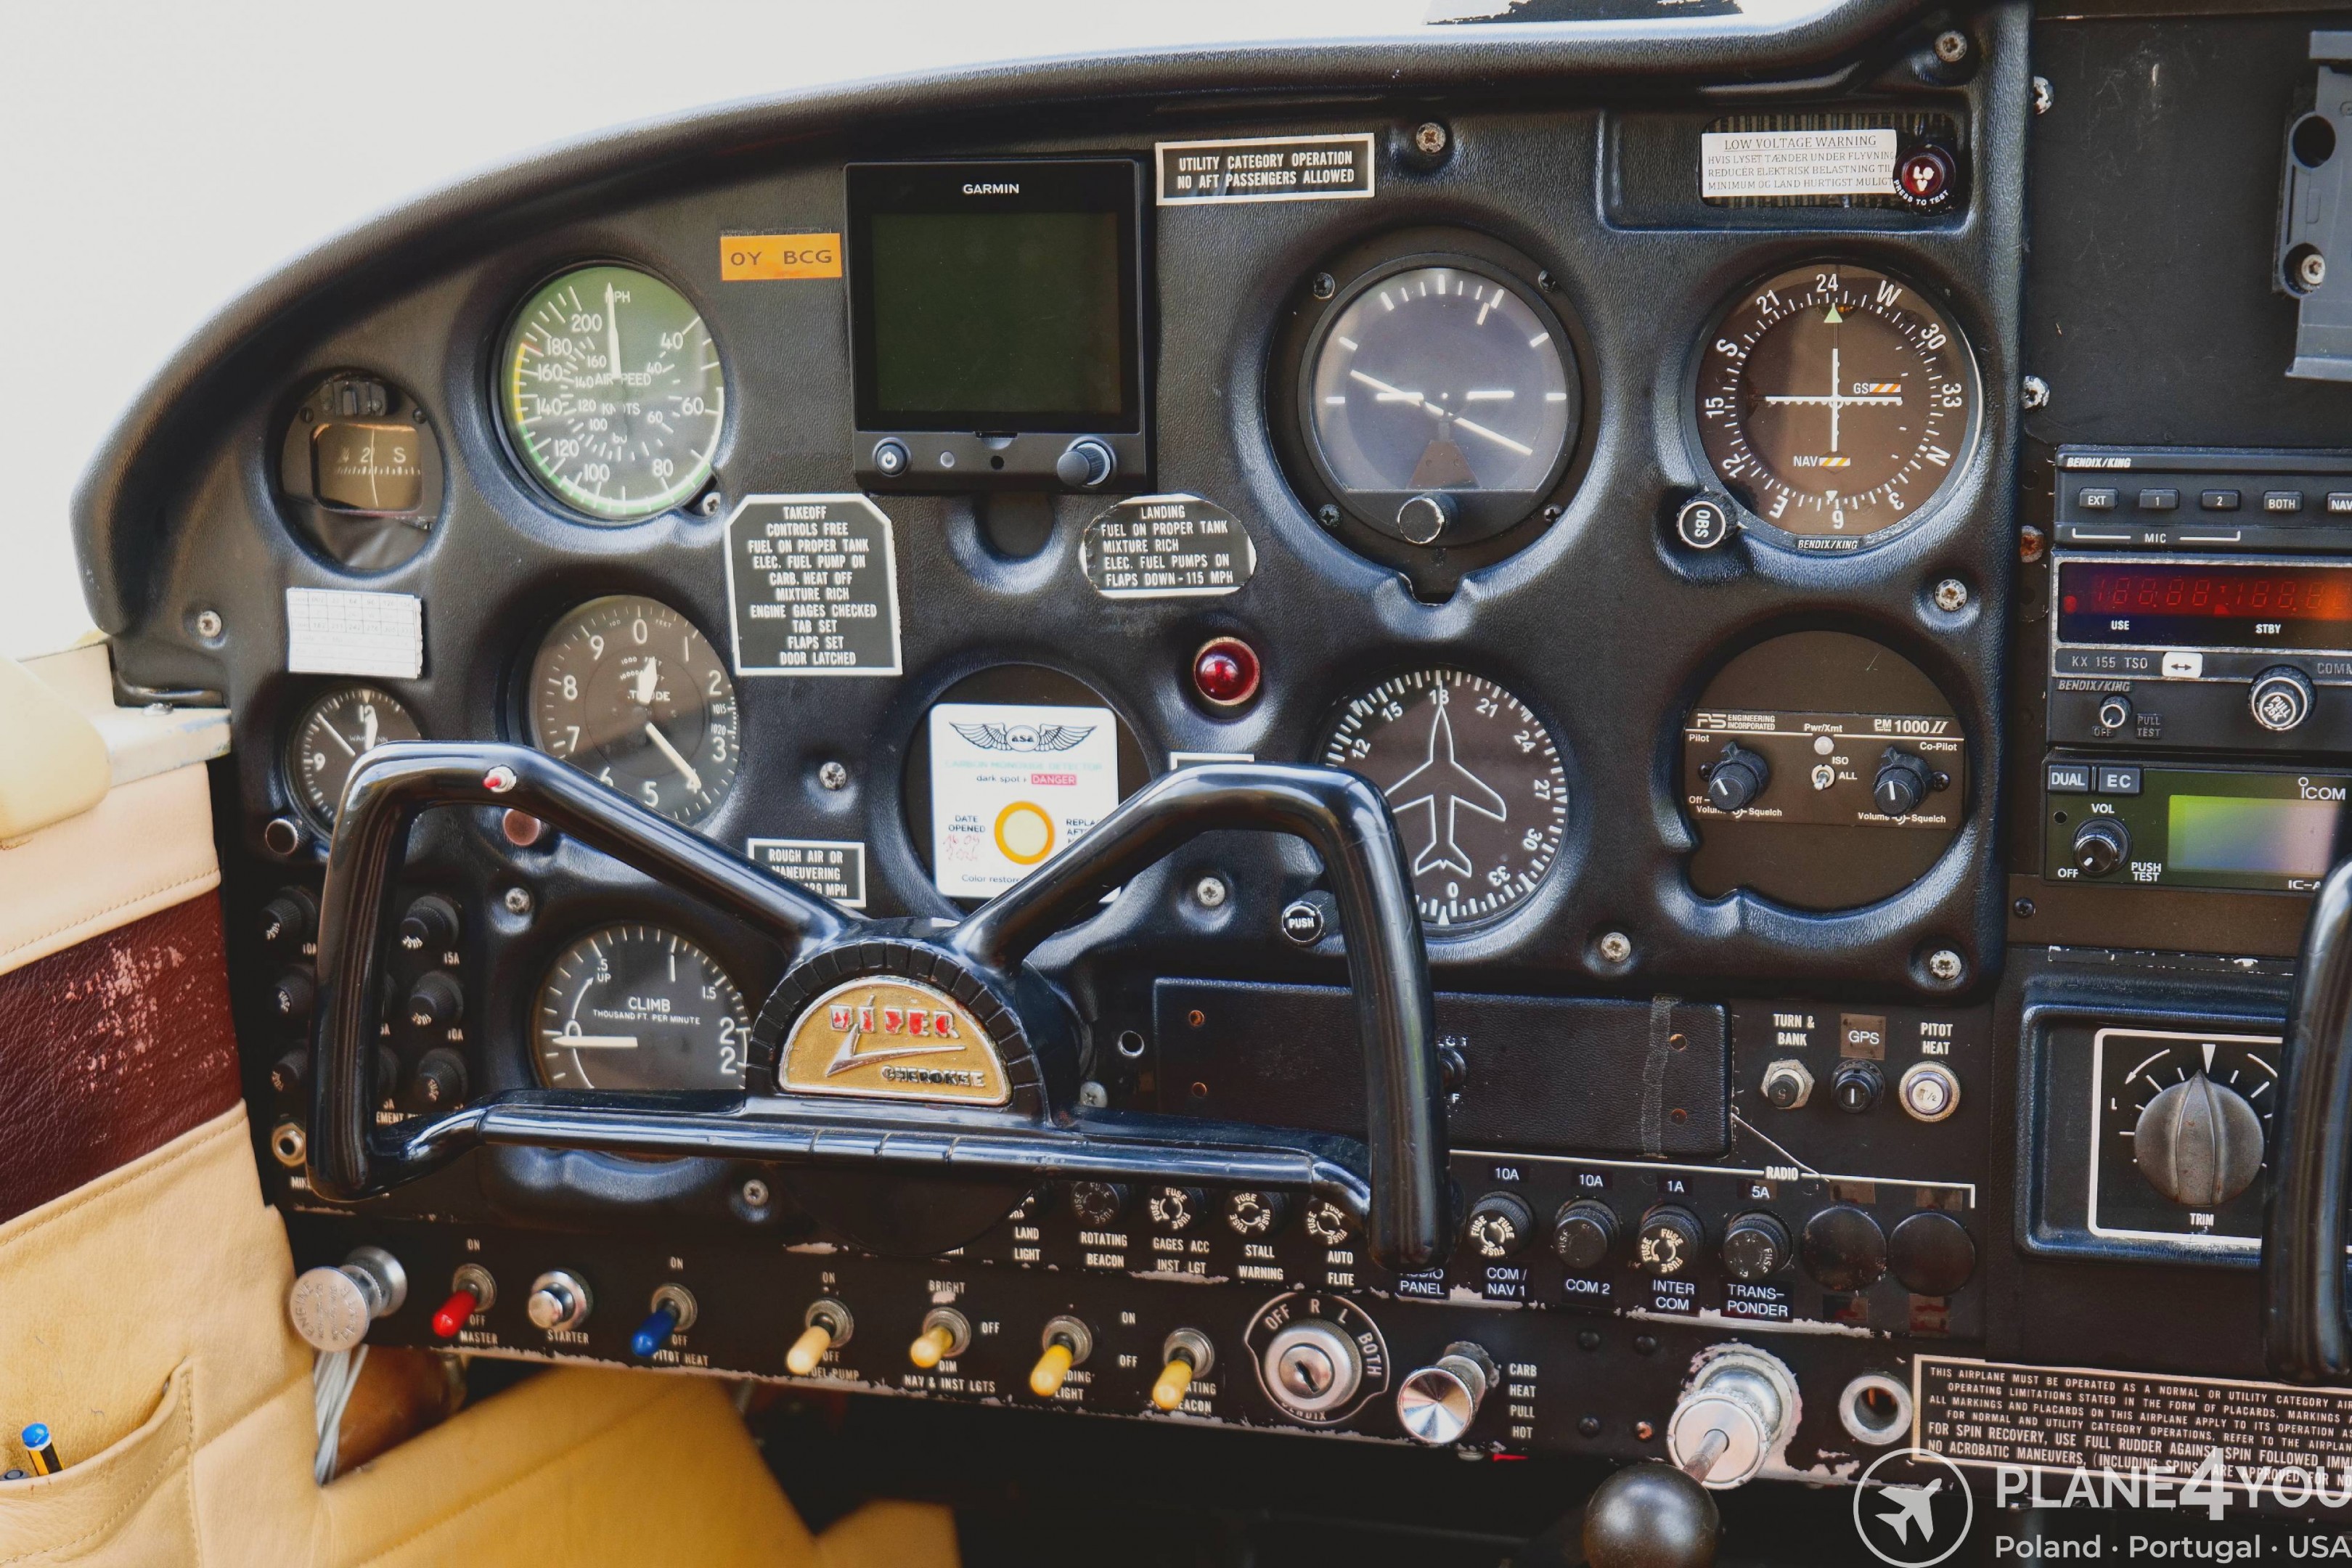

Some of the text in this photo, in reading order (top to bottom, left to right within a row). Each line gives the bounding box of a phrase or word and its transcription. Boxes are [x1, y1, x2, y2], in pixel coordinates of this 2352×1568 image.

[1725, 136, 1876, 150] LOW VOLTAGE WARNING
[1180, 151, 1352, 171] UTILITY CATEGORY OPERATION
[1708, 152, 1845, 164] HVIS LYSET TÆNDER UNDER
[1177, 169, 1354, 189] NO AFT PASSENGERS ALLOWED
[1709, 178, 1853, 189] MINIMUM OG LAND HURTIGST
[963, 184, 1019, 194] GARMIN
[731, 250, 832, 266] OY BCG
[1816, 274, 1837, 292] 24
[1878, 280, 1902, 306] W
[572, 314, 601, 332] 200
[547, 339, 572, 356] 180
[537, 364, 563, 381] 160
[1853, 383, 1869, 393] GS
[682, 399, 703, 415] 60
[1794, 456, 1818, 466] NAV
[2067, 457, 2131, 468] BENDIX/KING
[584, 463, 610, 481] 100
[653, 460, 674, 477] 80
[2088, 495, 2106, 506] EXT
[2269, 497, 2295, 510] BOTH
[783, 507, 827, 520] TAKEOFF
[1141, 505, 1185, 520] LANDING
[767, 523, 849, 536] CONTROLS FREE
[1101, 520, 1228, 537] FUEL ON PROPER TANK
[1694, 509, 1710, 538] OBS
[1798, 539, 1858, 549] BENDIX/KING
[2144, 532, 2166, 543] MIC
[748, 539, 869, 553] FUEL ON PROPER TANK
[1103, 539, 1179, 552] MIXTURE RICH
[754, 555, 865, 569] ELEC. FUEL PUMP ON
[776, 588, 849, 600] MIXTURE RICH
[751, 605, 877, 618] ENGINE GAGES CHECKED
[2111, 621, 2129, 631] USE
[2256, 624, 2281, 634] STBY
[780, 652, 856, 665] DOOR LATCHED
[2072, 656, 2148, 669] KX 155 TSO
[564, 676, 577, 700] 8
[1475, 698, 1498, 718] 21
[1728, 714, 1775, 723] ENGINEERING
[1805, 724, 1842, 733] Pwr/Xmt
[1895, 720, 1930, 733] 1000
[1920, 741, 1957, 751] Co-Pilot
[1832, 756, 1849, 765] ISO
[1032, 775, 1075, 784] DANGER
[2051, 772, 2085, 786] DUAL
[2107, 775, 2131, 788] EC
[1749, 808, 1782, 817] Squelch
[2091, 804, 2115, 814] VOL
[769, 849, 843, 863] ROUGH AIR OR
[2058, 868, 2078, 878] OFF
[2131, 862, 2161, 873] PUSH
[2133, 871, 2160, 882] TEST
[827, 884, 847, 897] MPH
[1289, 918, 1315, 928] PUSH
[703, 987, 716, 1000] 1.5
[628, 997, 670, 1012] CLIMB
[593, 1009, 635, 1020] THOUSAND
[670, 1016, 701, 1025] MINUTE
[1773, 1014, 1815, 1028] TURN &
[1922, 1022, 1953, 1037] PITOT
[1778, 1032, 1807, 1046] BANK
[1849, 1030, 1879, 1044] GPS
[1923, 1042, 1950, 1054] HEAT
[1495, 1168, 1519, 1181] 10A
[1765, 1167, 1798, 1180] RADIO
[1578, 1174, 1603, 1188] 10A
[2190, 1213, 2214, 1226] TRIM
[1081, 1231, 1127, 1247] ROTATING
[1153, 1238, 1209, 1252] GAGES ACC
[1015, 1249, 1040, 1261] LIGHT
[1246, 1244, 1275, 1258] STALL
[1328, 1251, 1352, 1264] AUTO
[1087, 1254, 1124, 1267] BEACON
[1238, 1265, 1283, 1281] WARNING
[1328, 1273, 1355, 1286] FLITE
[928, 1280, 965, 1294] BRIGHT
[1400, 1281, 1445, 1294] PANEL
[1566, 1279, 1610, 1294] COM 2
[1654, 1280, 1694, 1294] INTER
[1728, 1283, 1784, 1299] TRANS-
[1310, 1299, 1320, 1313] R
[1656, 1297, 1689, 1310] COM
[1728, 1301, 1788, 1316] PONDER
[1122, 1312, 1136, 1324] ON
[1265, 1304, 1289, 1330] OFF
[982, 1322, 1000, 1334] OFF
[460, 1331, 497, 1344] MASTER
[547, 1329, 589, 1344] STARTER
[685, 1353, 709, 1366] HEAT
[1358, 1332, 1382, 1377] BOTH
[1119, 1355, 1138, 1368] OFF
[1510, 1363, 1537, 1377] CARB
[1931, 1367, 2115, 1392] THIS AIRPLANE MUST BE OPERATED
[1510, 1384, 1536, 1397] HEAT
[1511, 1405, 1535, 1418] PULL
[1513, 1426, 1532, 1438] HOT
[1928, 1422, 2162, 1452] FOR SPIN RECOVERY, USE FULL RUDDER
